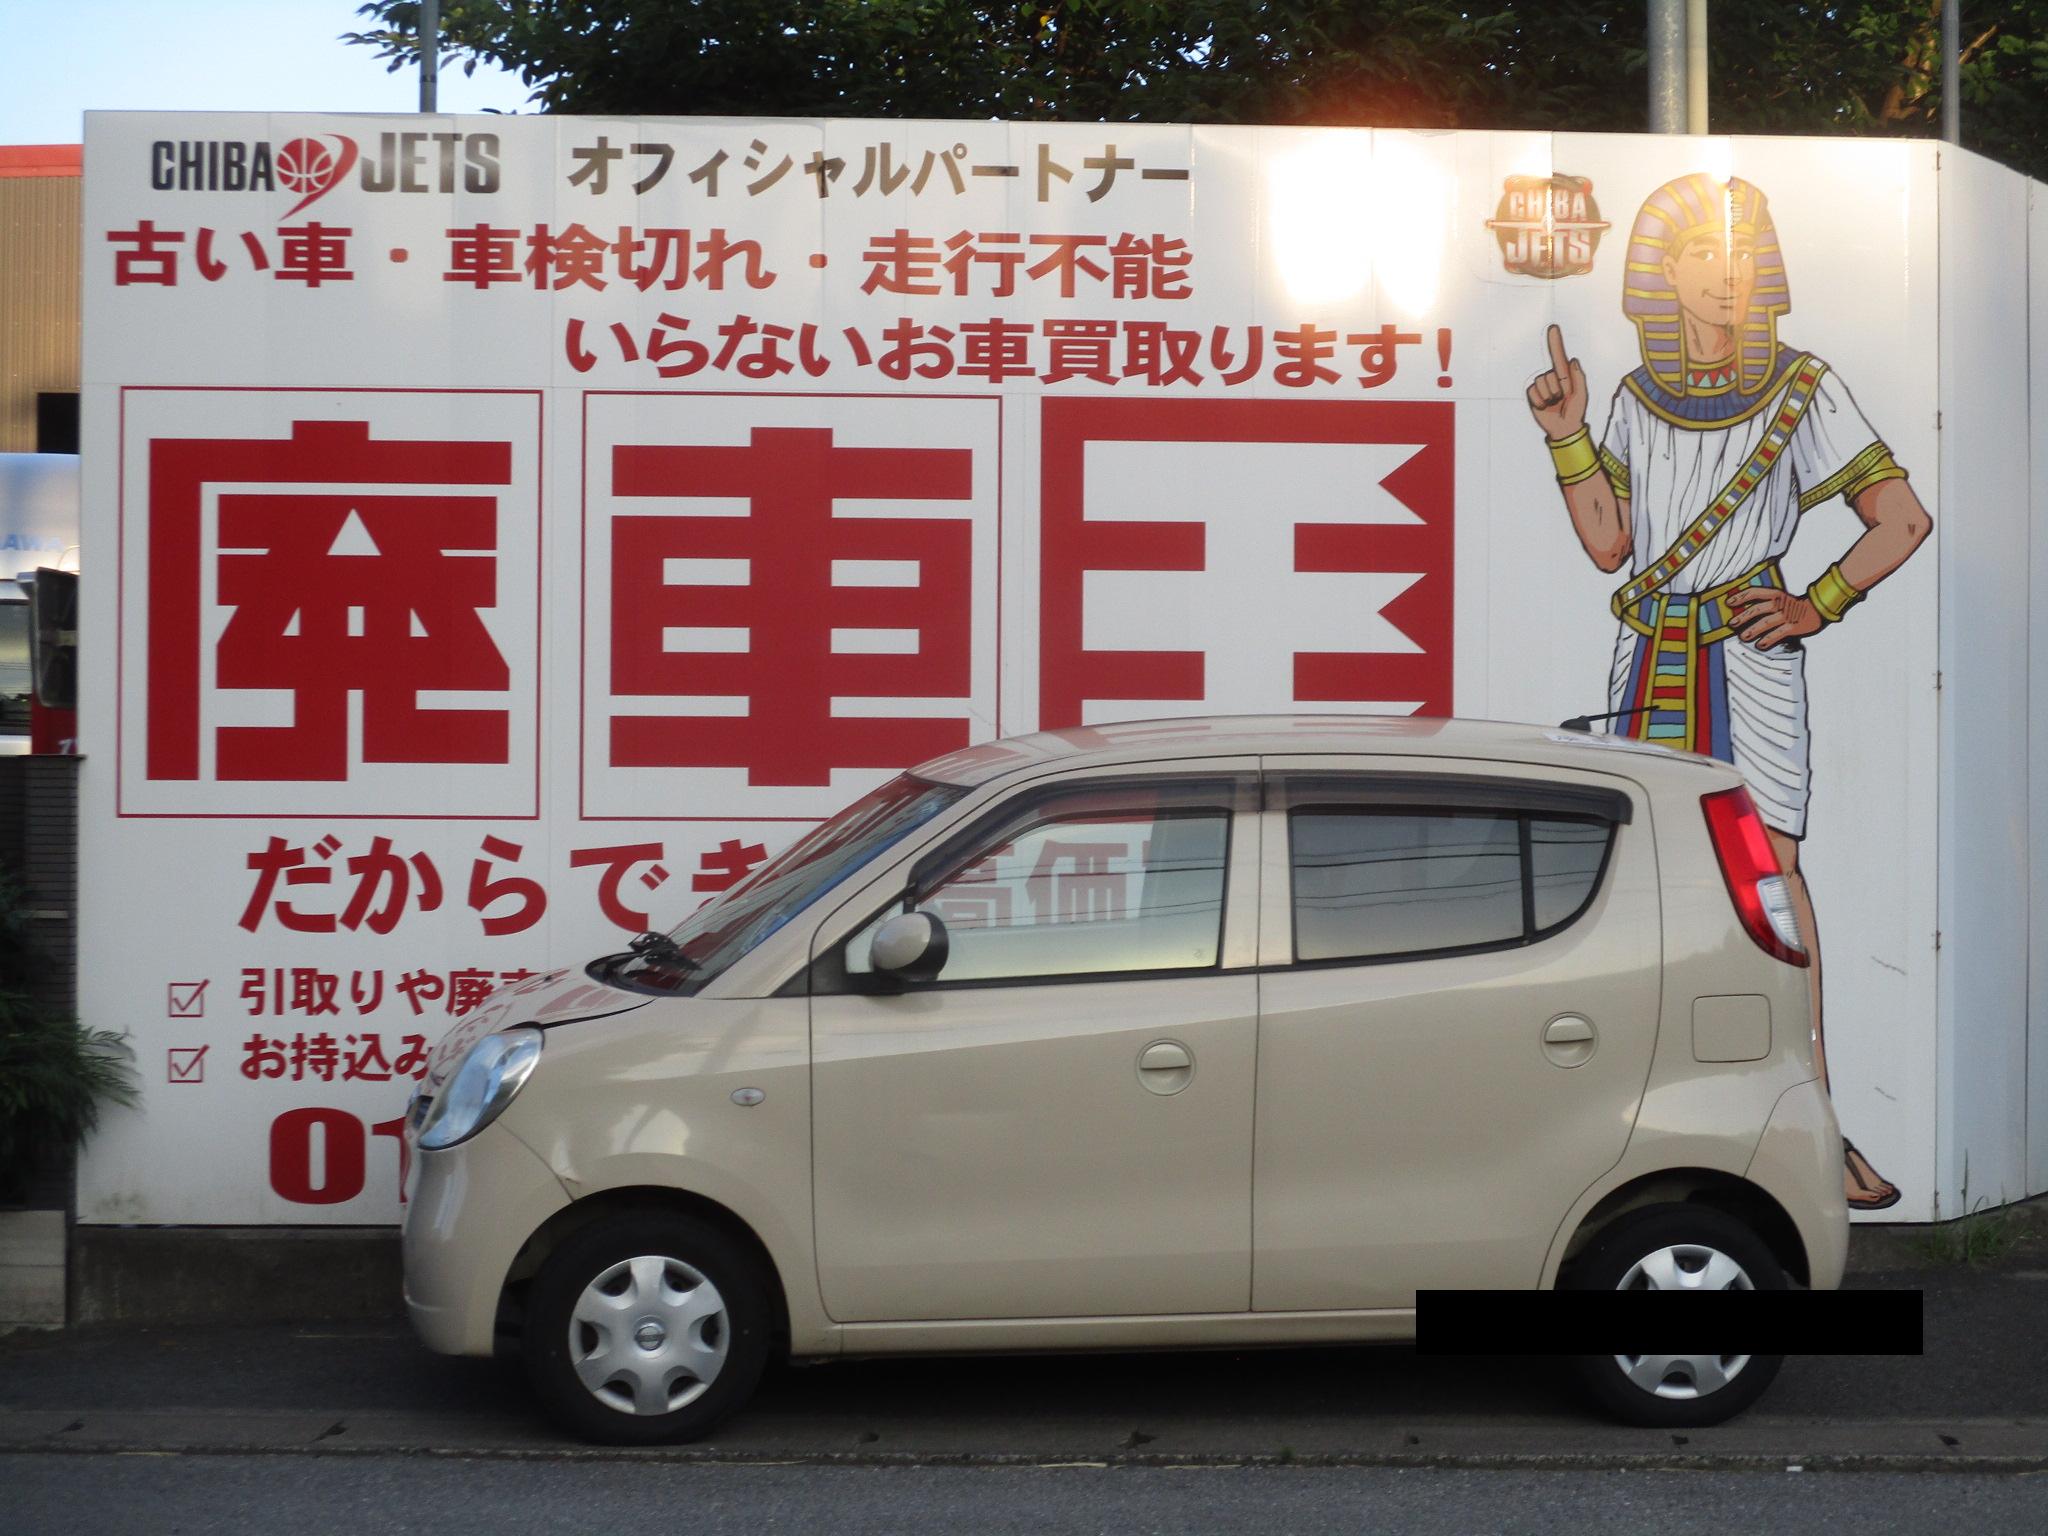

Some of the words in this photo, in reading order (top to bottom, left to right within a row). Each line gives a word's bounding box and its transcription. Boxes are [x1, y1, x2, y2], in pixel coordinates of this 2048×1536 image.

[151, 140, 273, 191] CHIBA
[361, 132, 500, 193] JETS
[568, 136, 1190, 203] オフィシャルパートナー
[1510, 189, 1588, 220] CHIBA
[1506, 227, 1591, 268] JETS
[566, 312, 1454, 388] いらないお車買取ります!
[241, 1032, 432, 1082] お持込み
